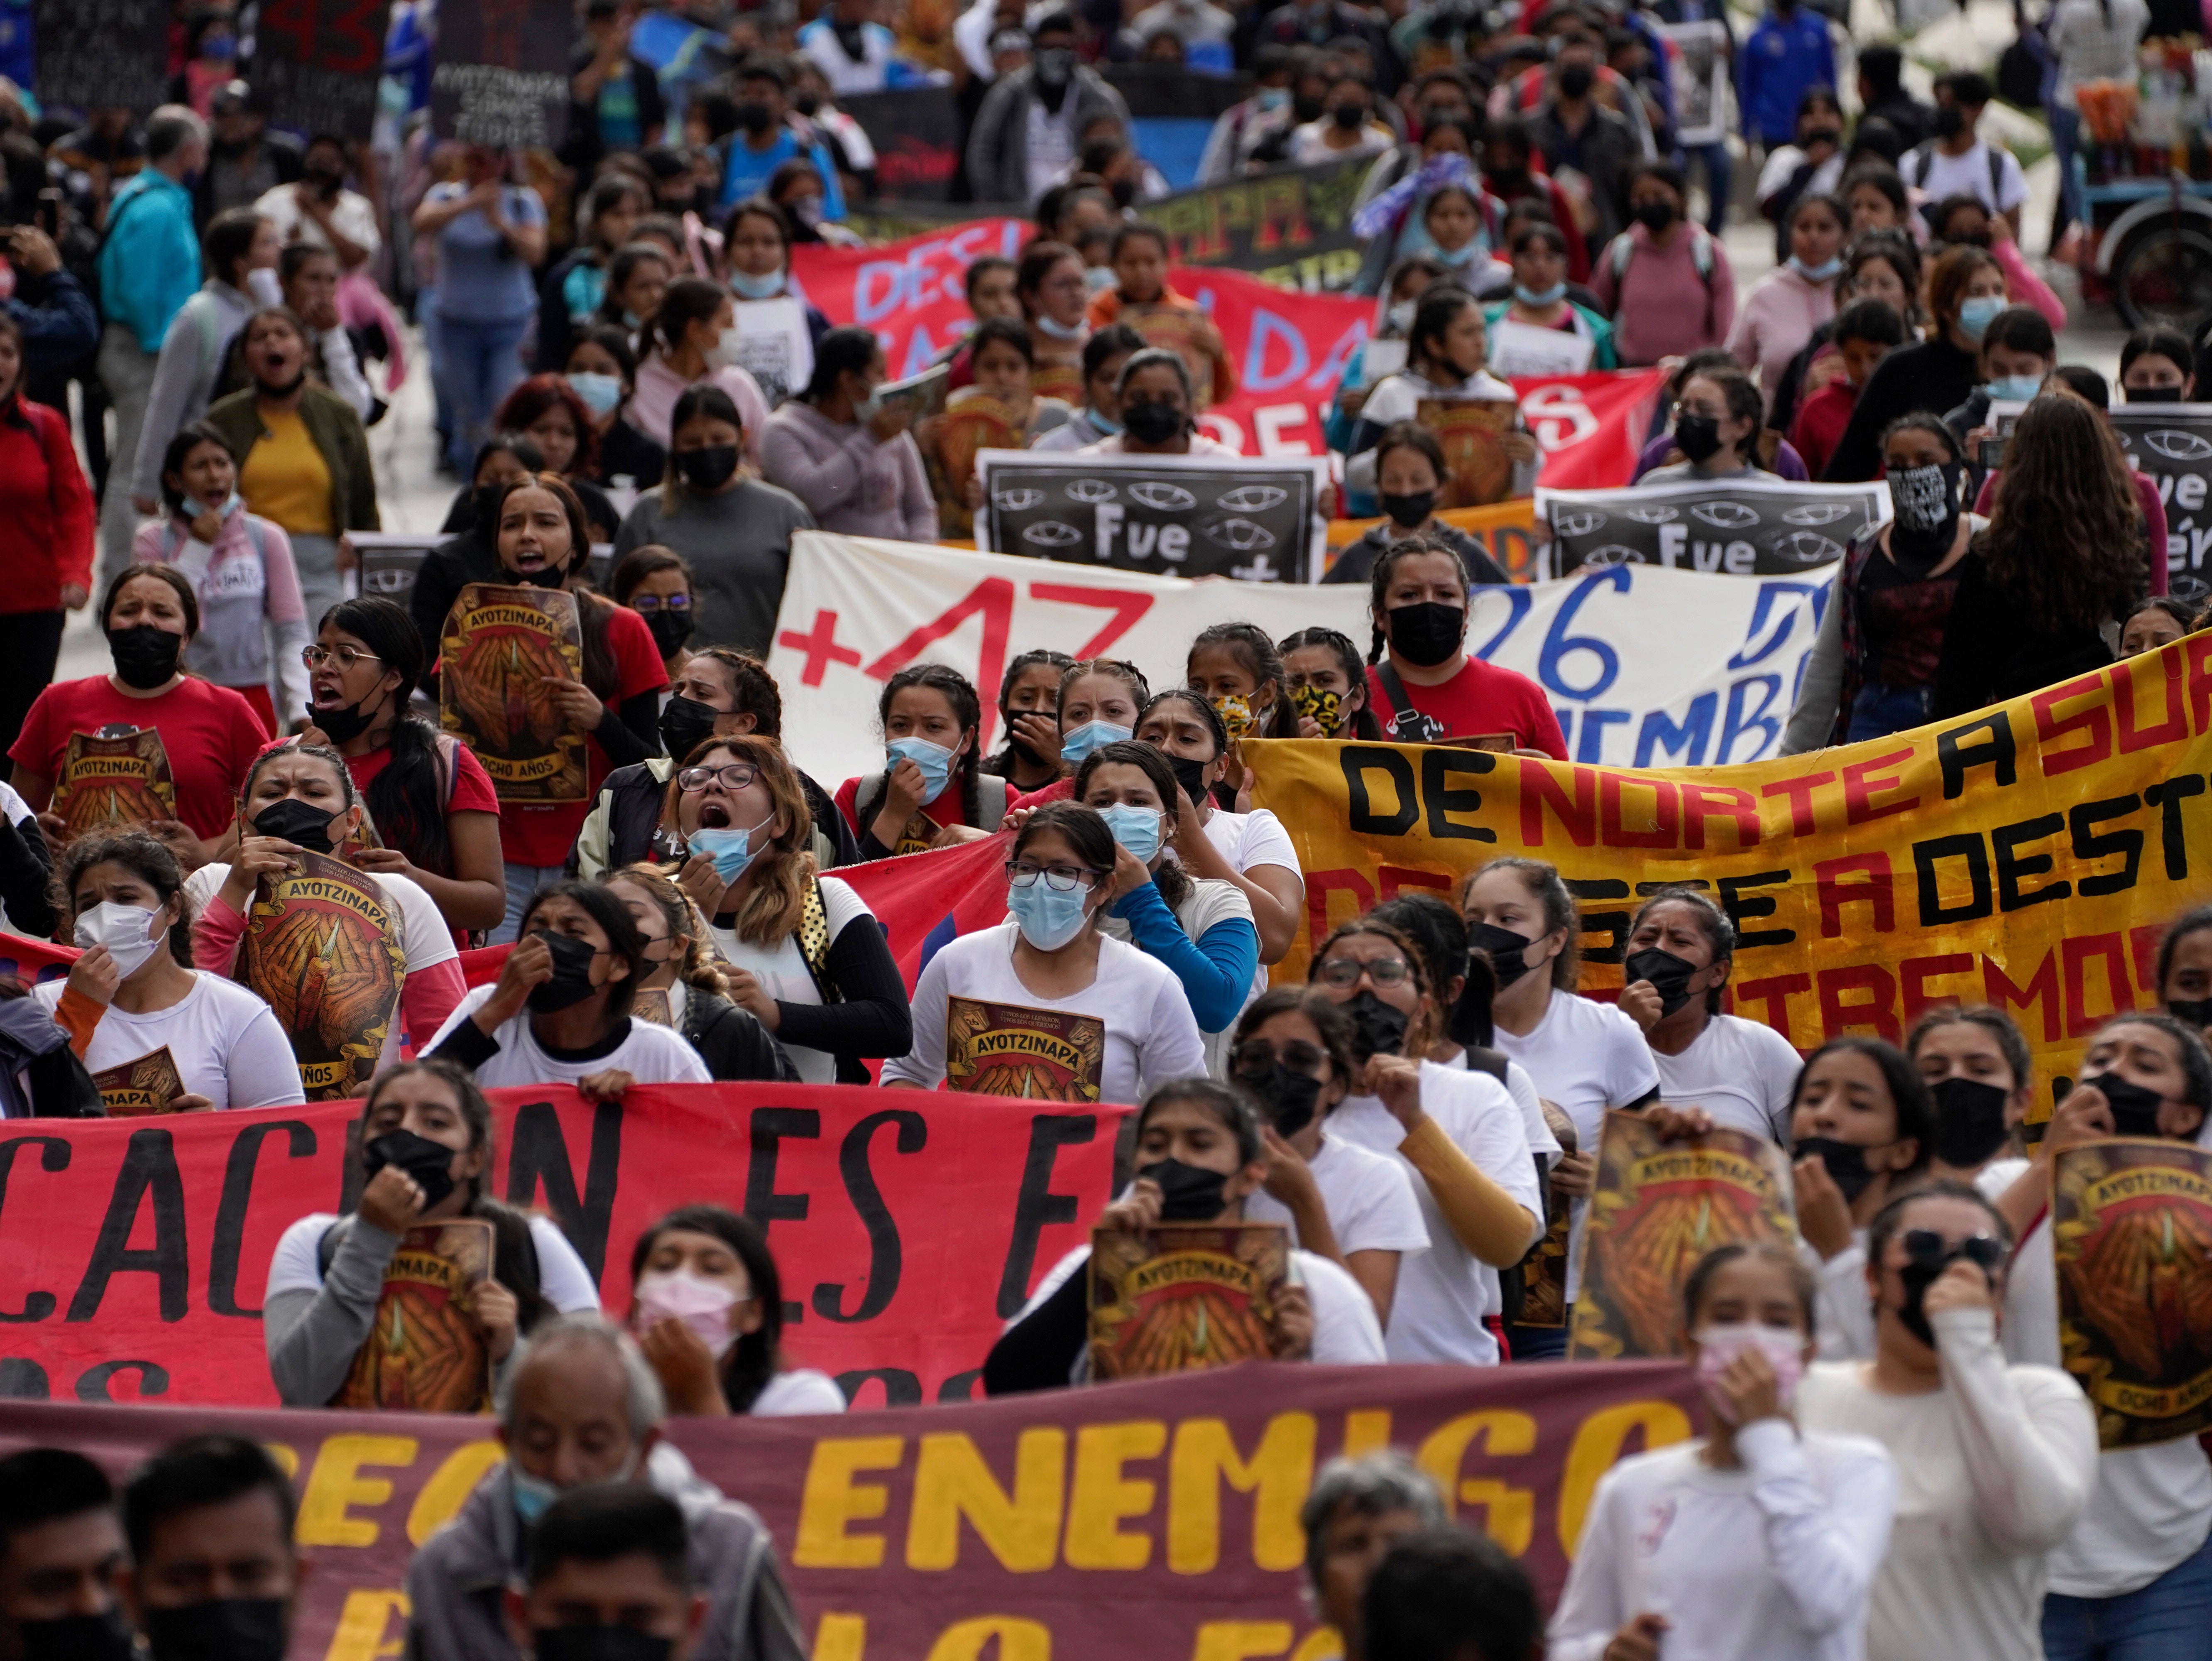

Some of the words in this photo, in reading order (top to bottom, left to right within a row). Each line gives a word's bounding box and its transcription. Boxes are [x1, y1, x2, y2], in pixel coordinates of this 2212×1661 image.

[263, 0, 383, 73] 43
[1094, 503, 1191, 562] Fue
[1659, 522, 1756, 575] Fue
[471, 608, 554, 633] AYOTZINAPA
[73, 760, 147, 777] AYOTZINAPA
[480, 756, 513, 777] OCHO
[1340, 746, 1496, 843] DE
[1520, 747, 1921, 850] NORTE
[1938, 711, 2017, 800] A
[318, 866, 334, 876] VIVOS
[1812, 851, 1896, 938] A
[1912, 772, 2212, 927] OEST
[289, 882, 388, 929] AYOTZINAPA
[977, 1033, 1081, 1069] AYOTZINAPA
[300, 1066, 333, 1084] ÑOS
[101, 1092, 152, 1107] NAPA
[743, 1107, 928, 1324] ES
[383, 1257, 449, 1281] INAPA
